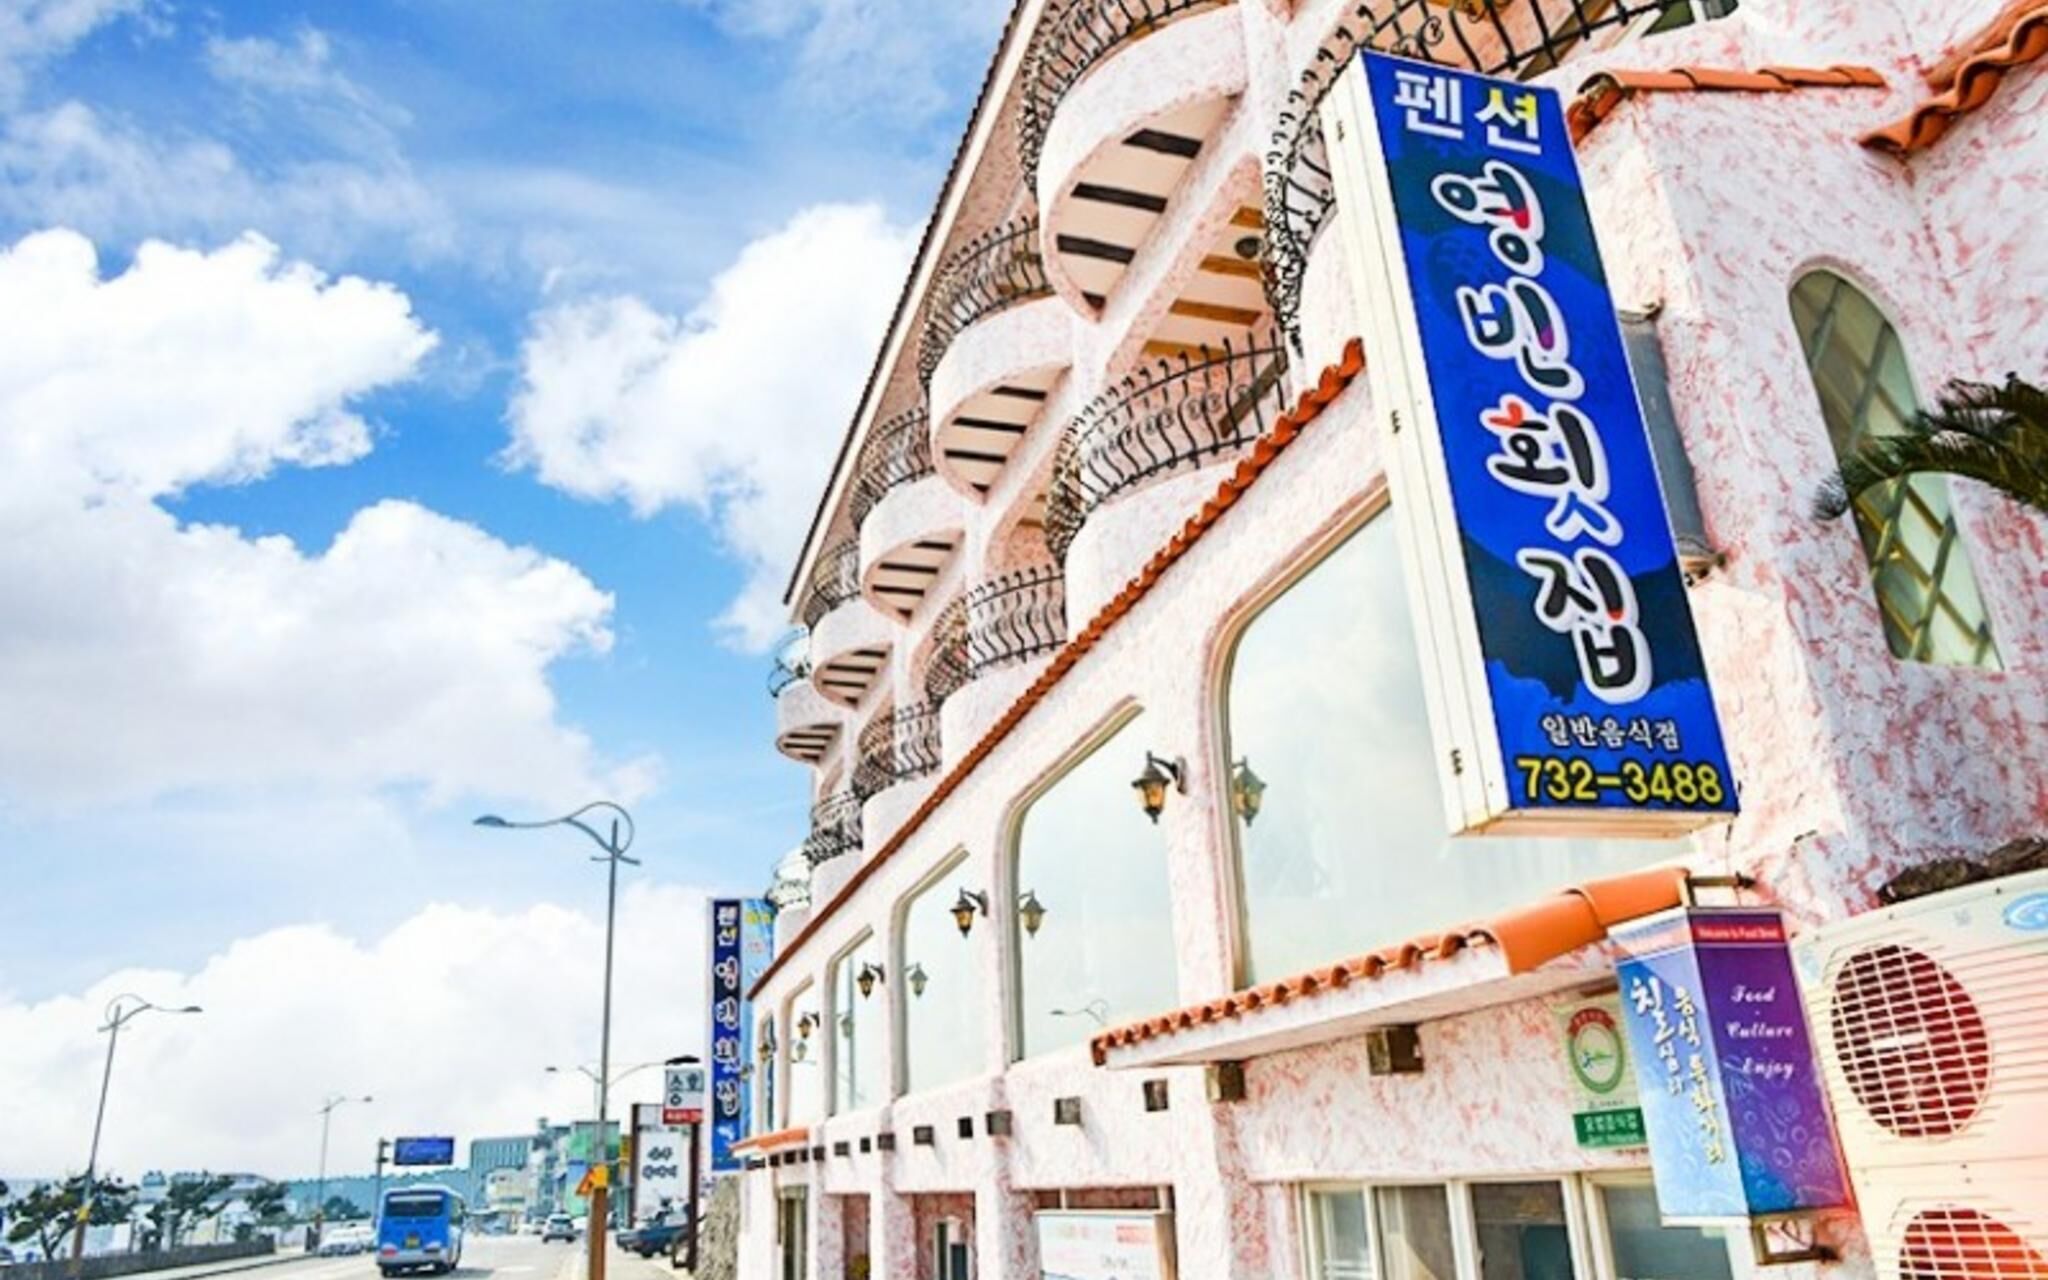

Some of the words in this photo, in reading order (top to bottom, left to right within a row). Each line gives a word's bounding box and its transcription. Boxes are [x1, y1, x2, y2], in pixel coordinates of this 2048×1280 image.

[1394, 70, 1541, 155] 펜션
[1431, 160, 1654, 705] 영빈횟집
[1542, 713, 1681, 752] 일반음식점
[1515, 755, 1724, 807] 732-3488
[1730, 984, 1776, 1003] Food
[1726, 1021, 1794, 1038] Culture
[1742, 1057, 1795, 1080] Enjoy
